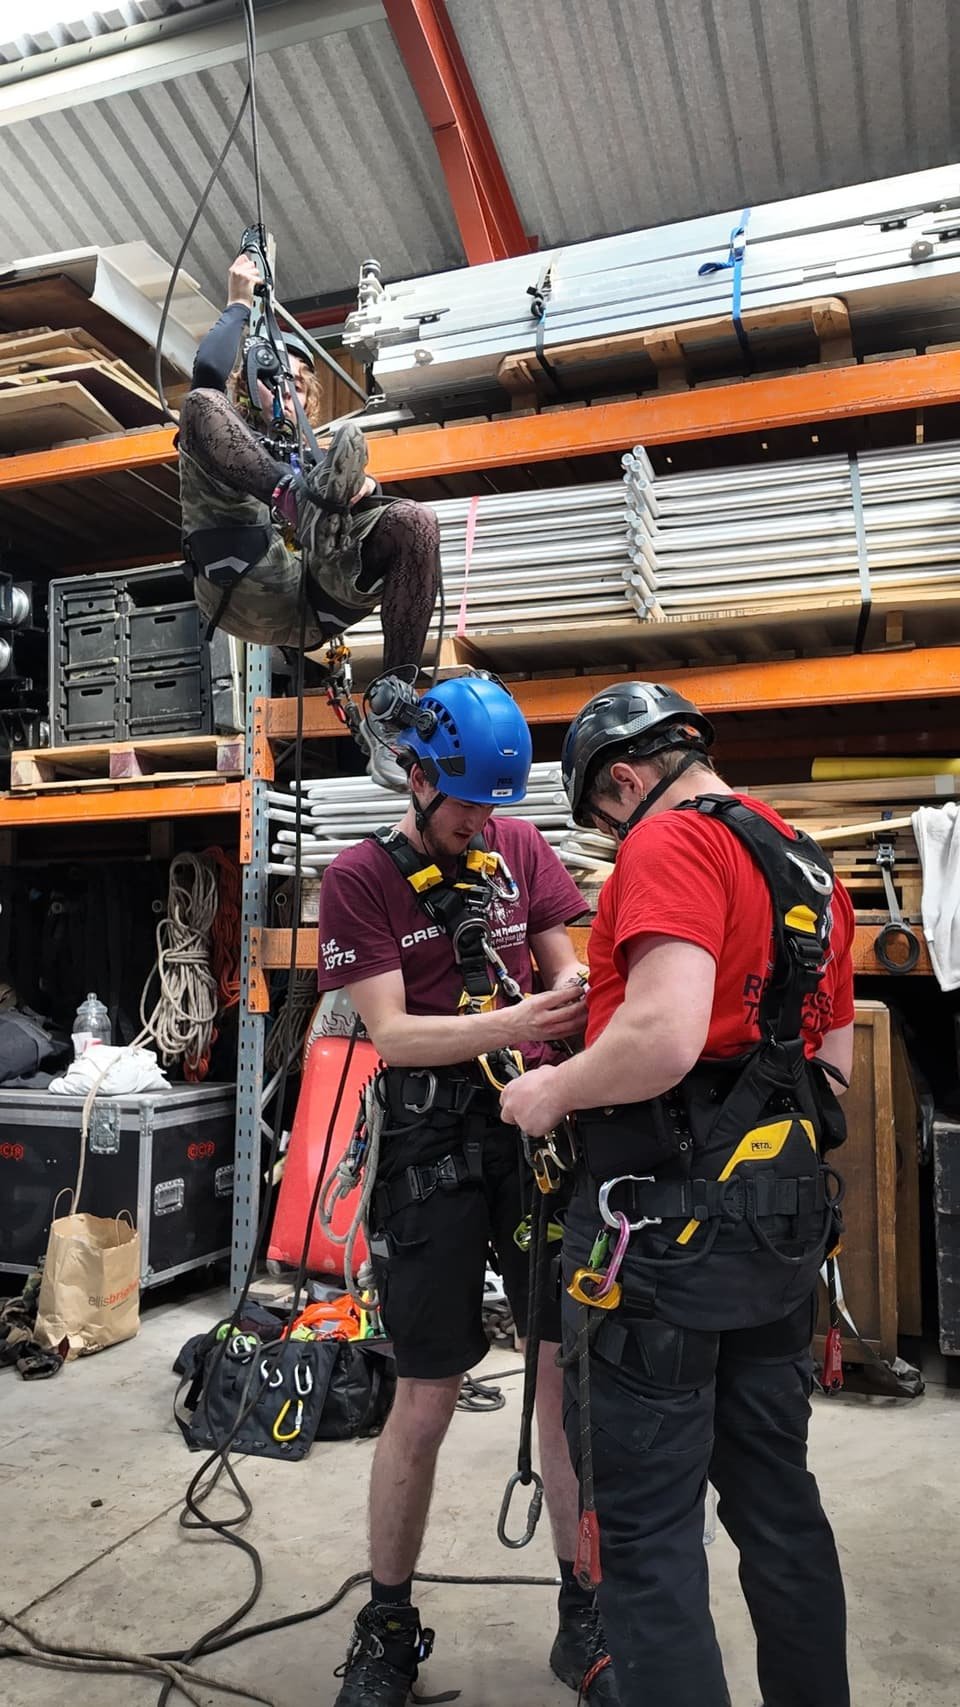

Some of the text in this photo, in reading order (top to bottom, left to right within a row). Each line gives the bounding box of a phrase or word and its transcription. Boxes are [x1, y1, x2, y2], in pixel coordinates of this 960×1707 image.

[320, 938, 340, 957] Est.
[324, 949, 357, 971] 1975
[751, 1142, 773, 1152] PETZL
